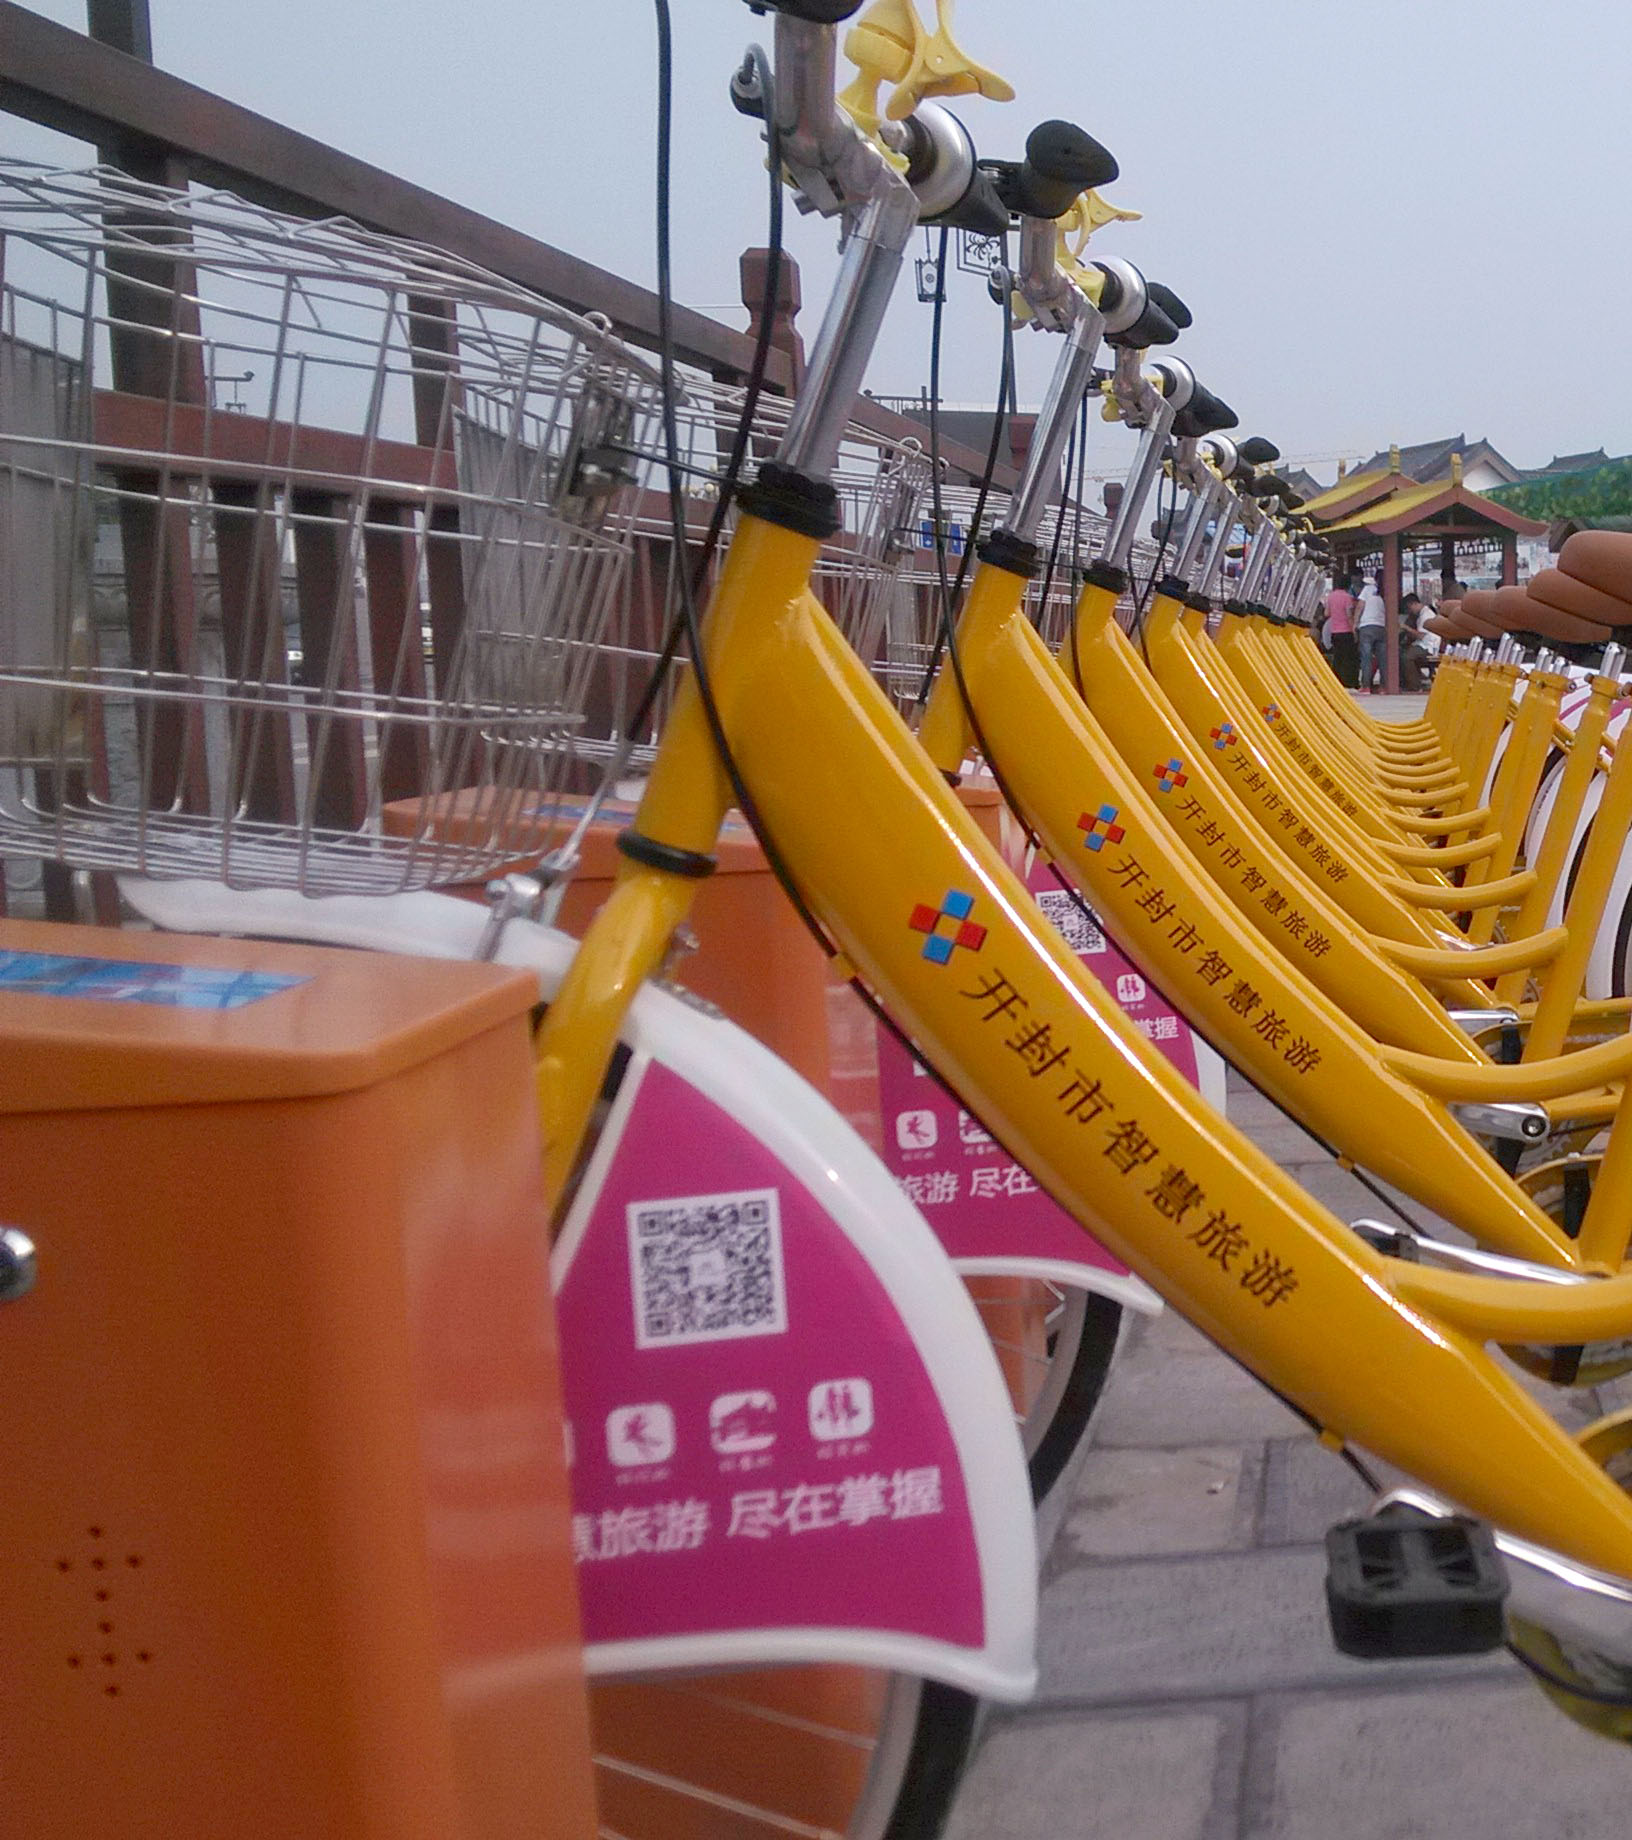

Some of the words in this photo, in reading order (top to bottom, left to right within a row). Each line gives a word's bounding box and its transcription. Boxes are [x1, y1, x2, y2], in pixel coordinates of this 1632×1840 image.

[1176, 795, 1332, 959] 开封市智慧旅游
[1228, 752, 1350, 885] 开封市智慧旅游
[1107, 854, 1322, 1075] 开封市智慧旅游
[961, 968, 1301, 1308] 开封市智慧旅游
